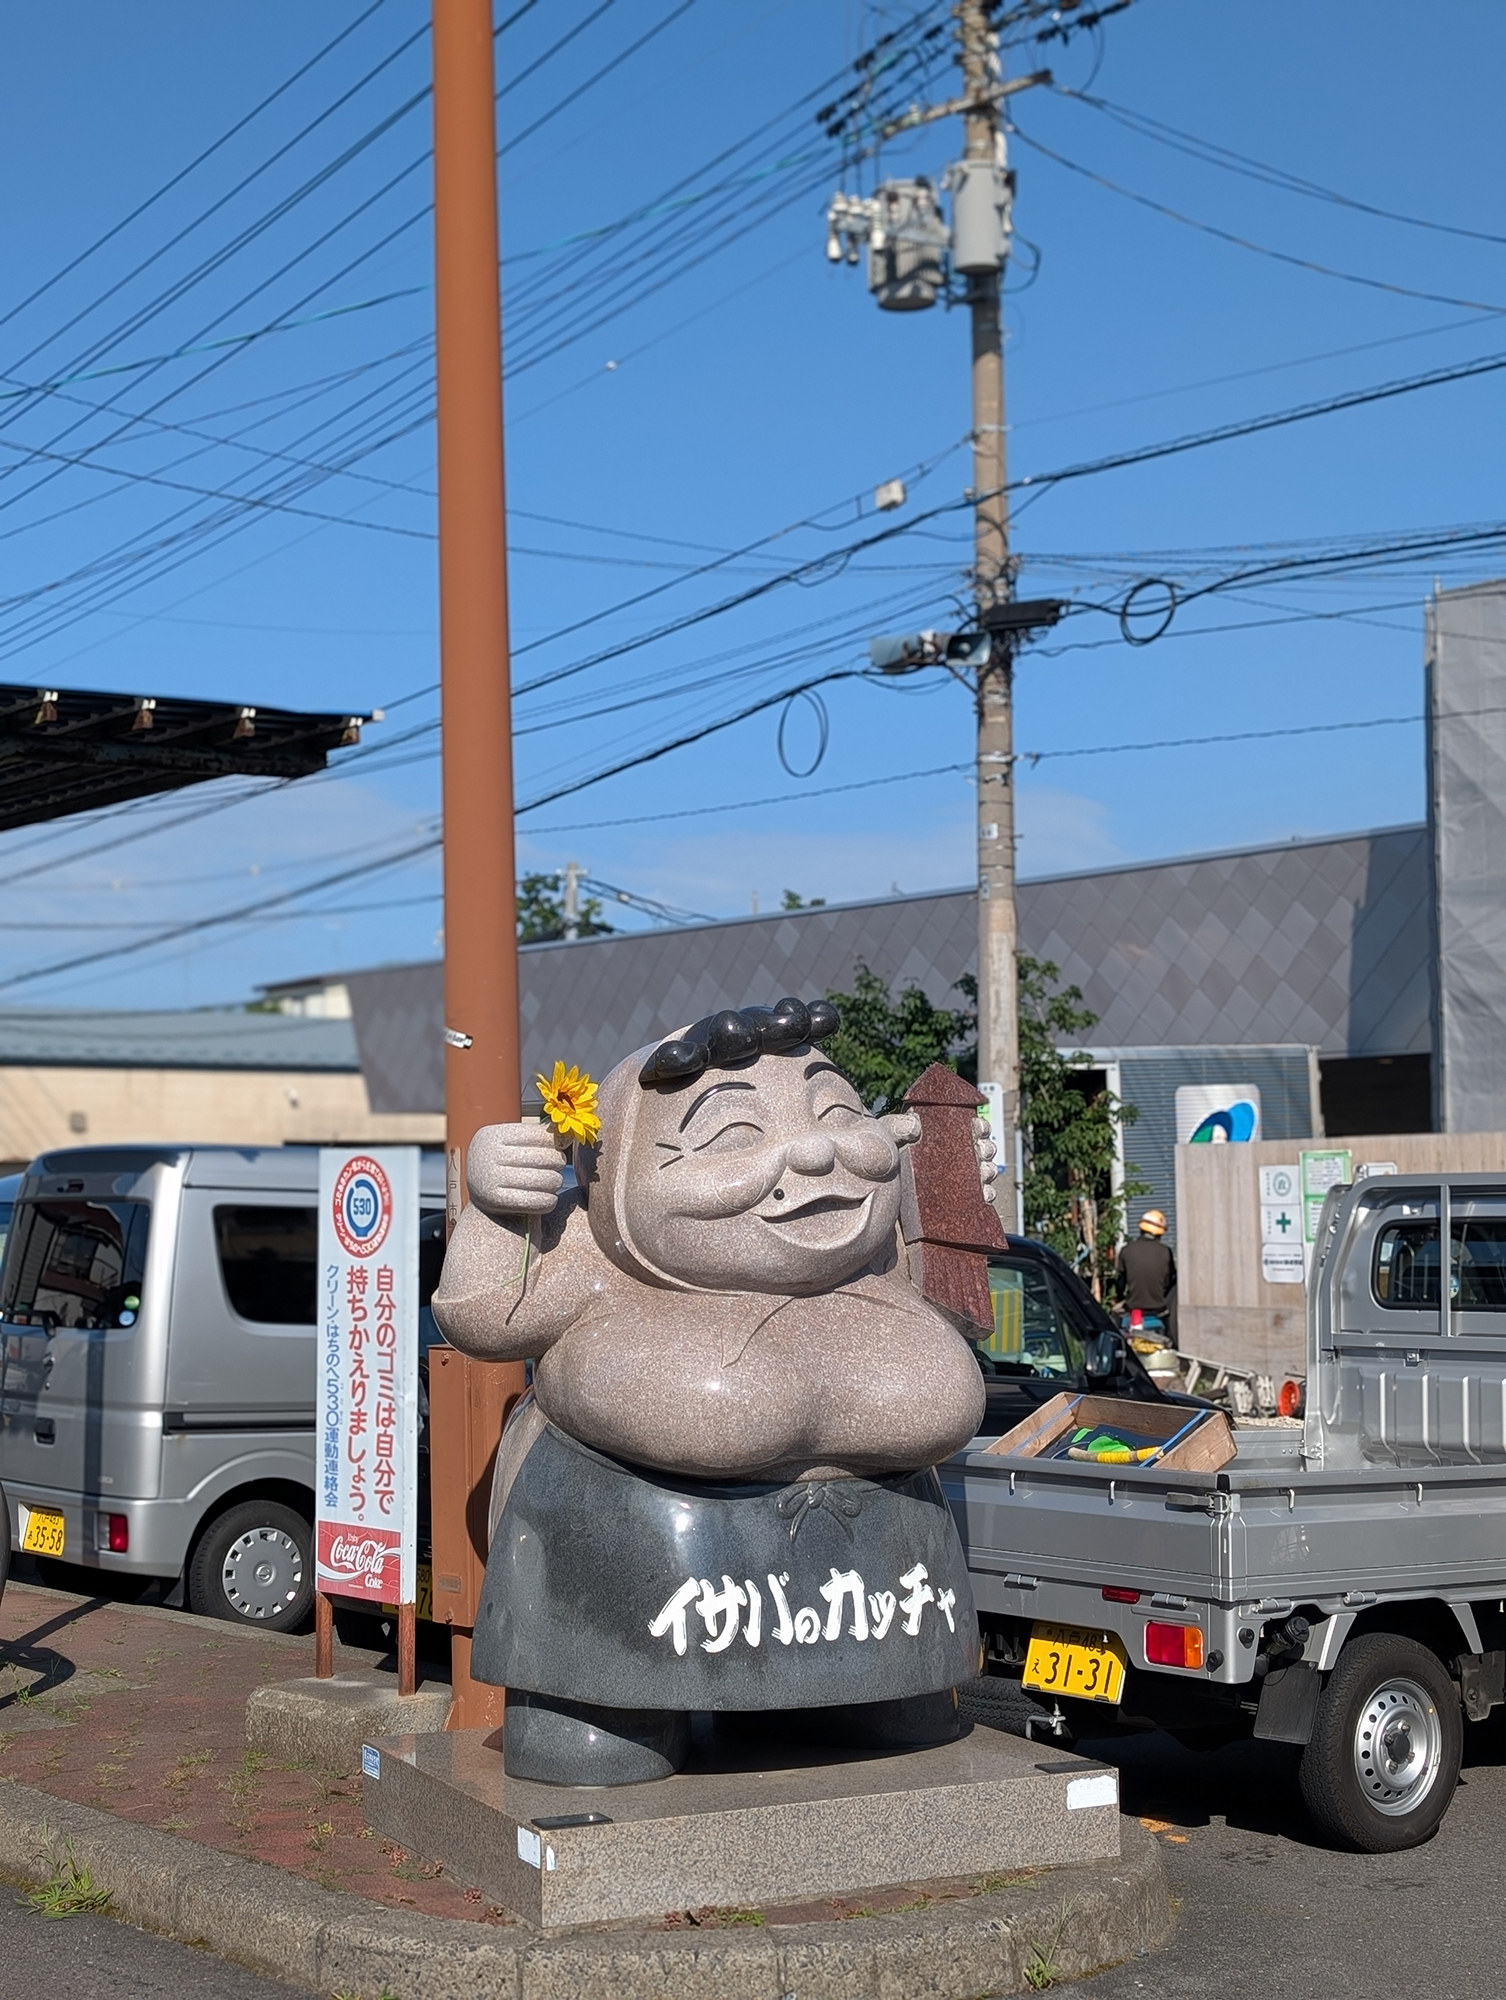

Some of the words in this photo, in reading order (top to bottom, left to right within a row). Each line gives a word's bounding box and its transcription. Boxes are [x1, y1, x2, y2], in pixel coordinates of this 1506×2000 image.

[353, 1198, 372, 1216] 530
[346, 1265, 370, 1522] 持ちかえりましょう。
[373, 1264, 397, 1515] 自分のゴミは自分で
[331, 1535, 387, 1574] Coca-Cola
[364, 1573, 384, 1589] Coke
[648, 1563, 956, 1656] イサバのカッチャ
[1031, 1658, 1040, 1674] え
[1044, 1652, 1113, 1694] 31-31
